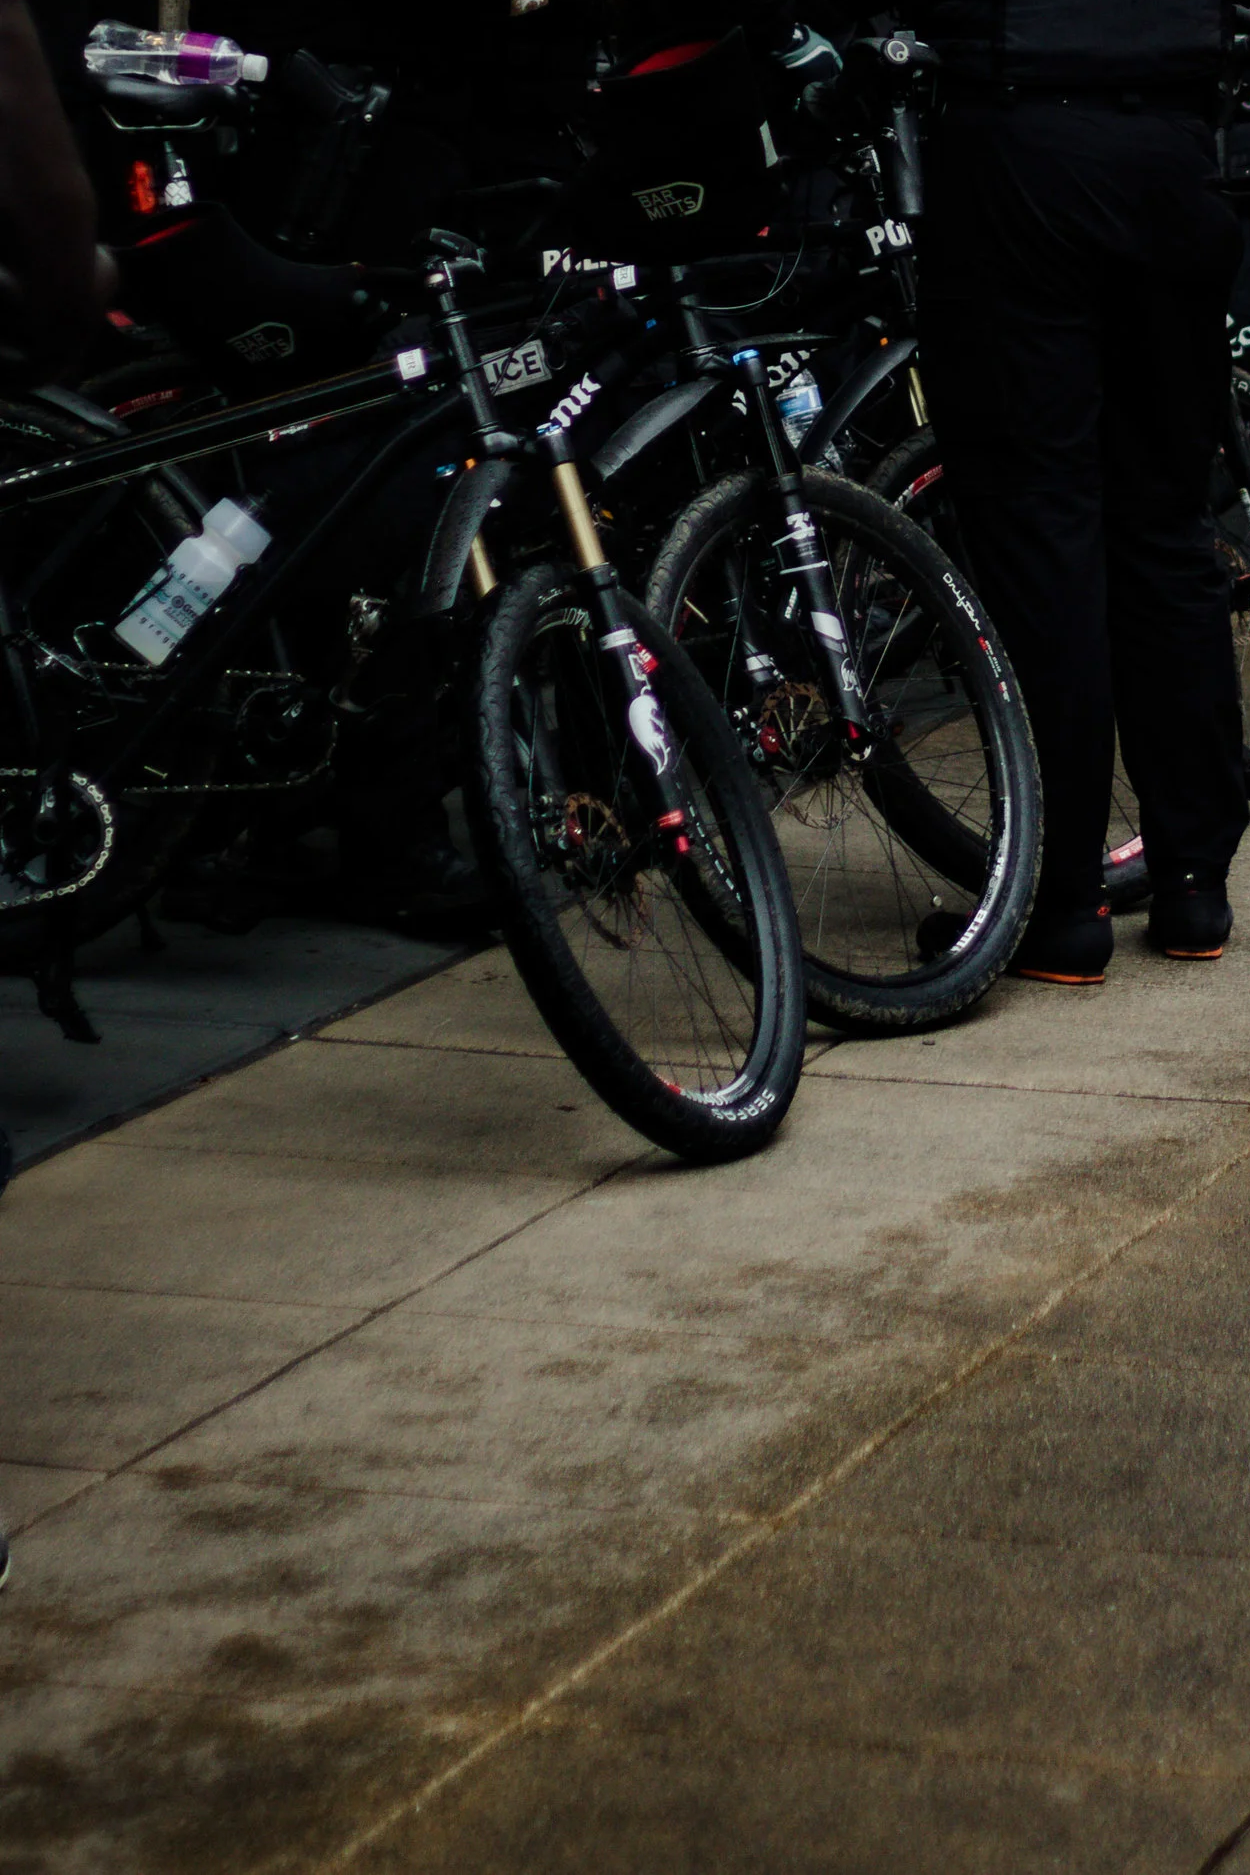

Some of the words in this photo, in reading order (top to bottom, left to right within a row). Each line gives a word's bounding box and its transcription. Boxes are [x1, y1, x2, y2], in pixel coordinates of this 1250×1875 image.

[638, 189, 676, 208] BAR
[646, 196, 697, 222] MITTS
[711, 1087, 776, 1121] SERFAS
